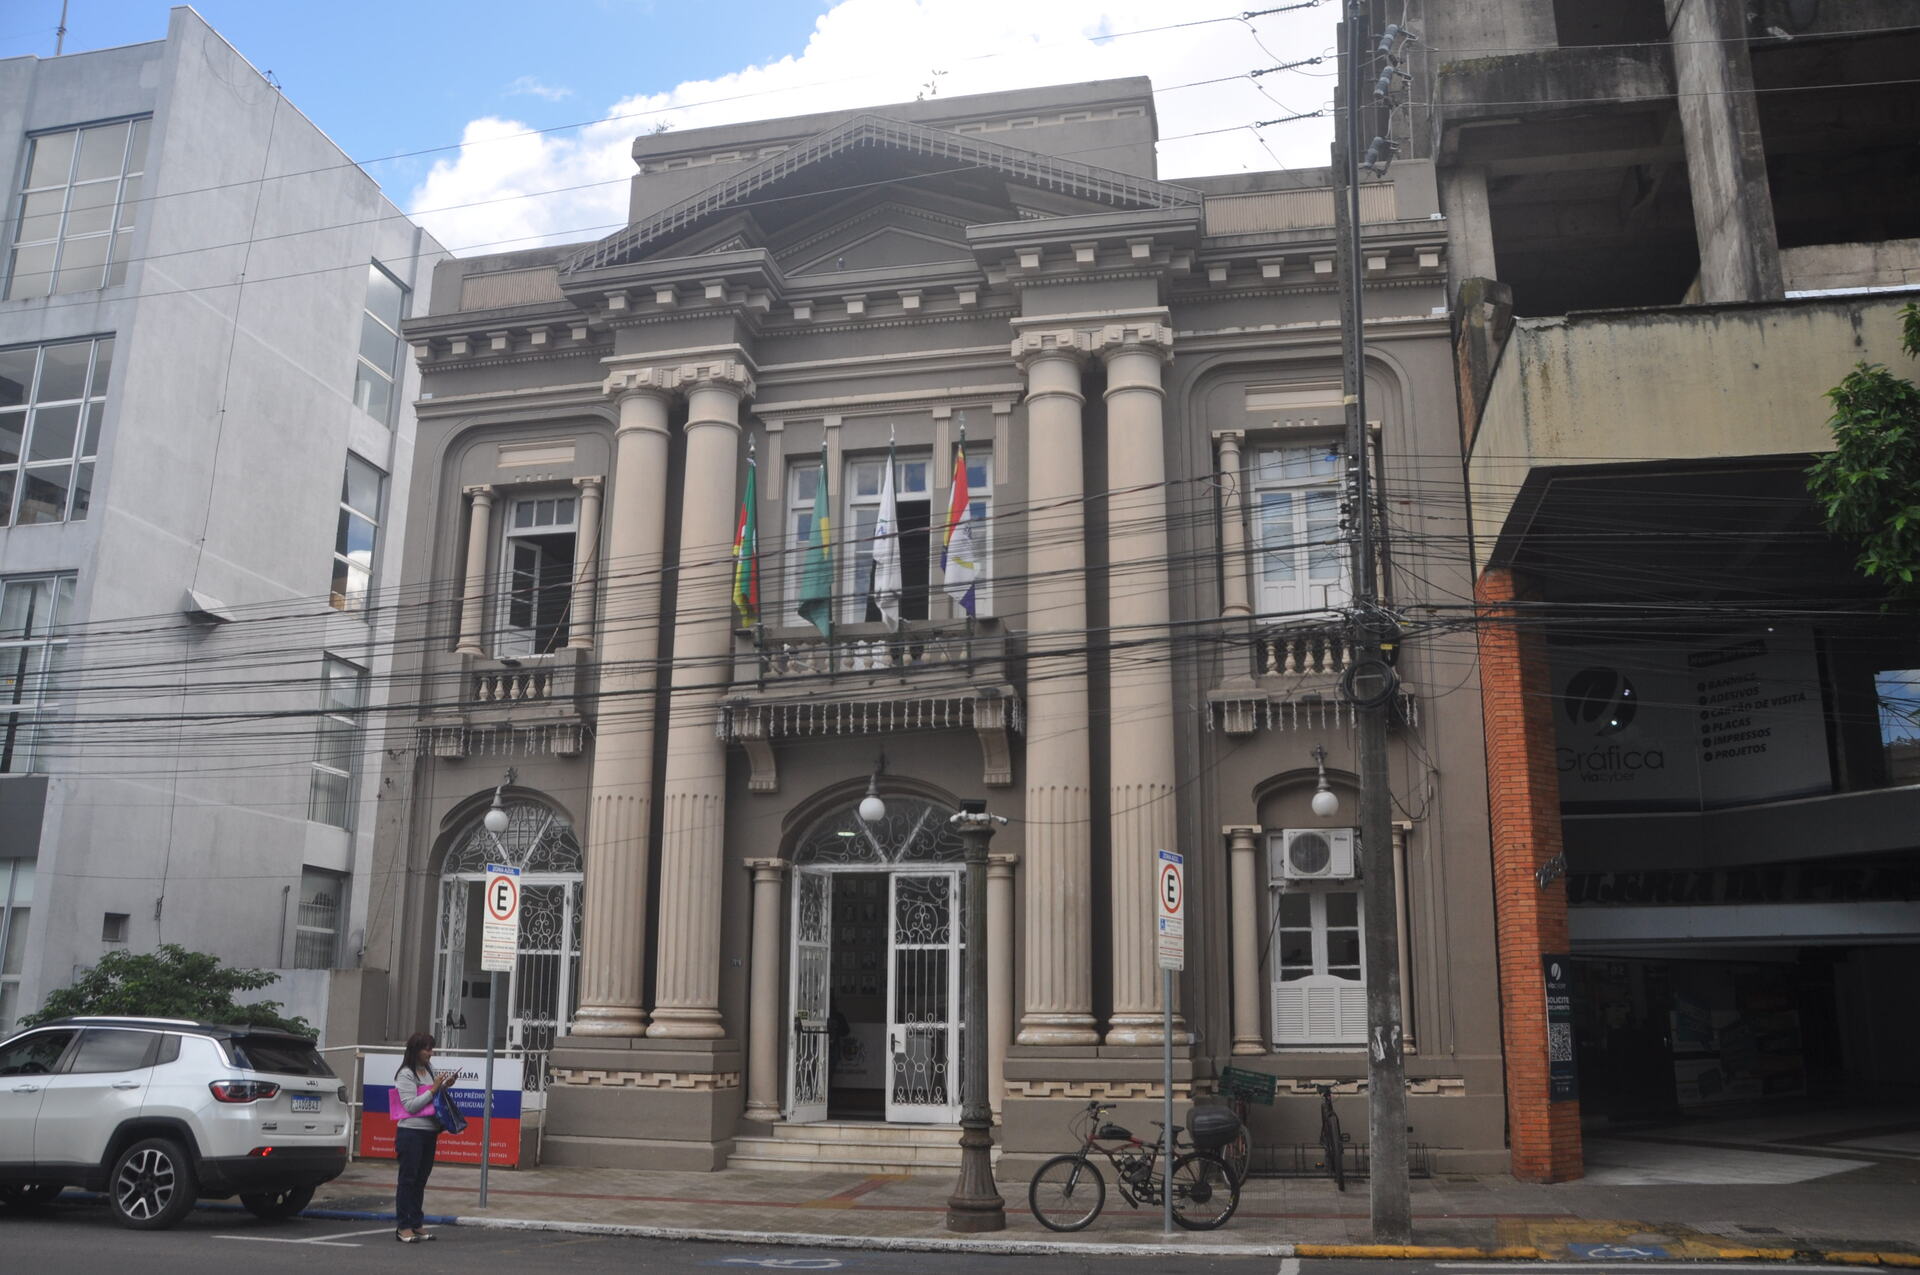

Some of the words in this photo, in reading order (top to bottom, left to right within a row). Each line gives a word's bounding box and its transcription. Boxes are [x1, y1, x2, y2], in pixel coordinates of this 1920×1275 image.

[1755, 698, 1769, 710] DE
[1771, 692, 1807, 708] VISITA
[1712, 717, 1752, 733] PLACAS
[1713, 727, 1772, 746] IMPRESSOS
[1556, 744, 1664, 772] Gráfica
[1715, 743, 1768, 761] PROJETOS
[497, 885, 508, 911] E
[1168, 874, 1175, 903] E
